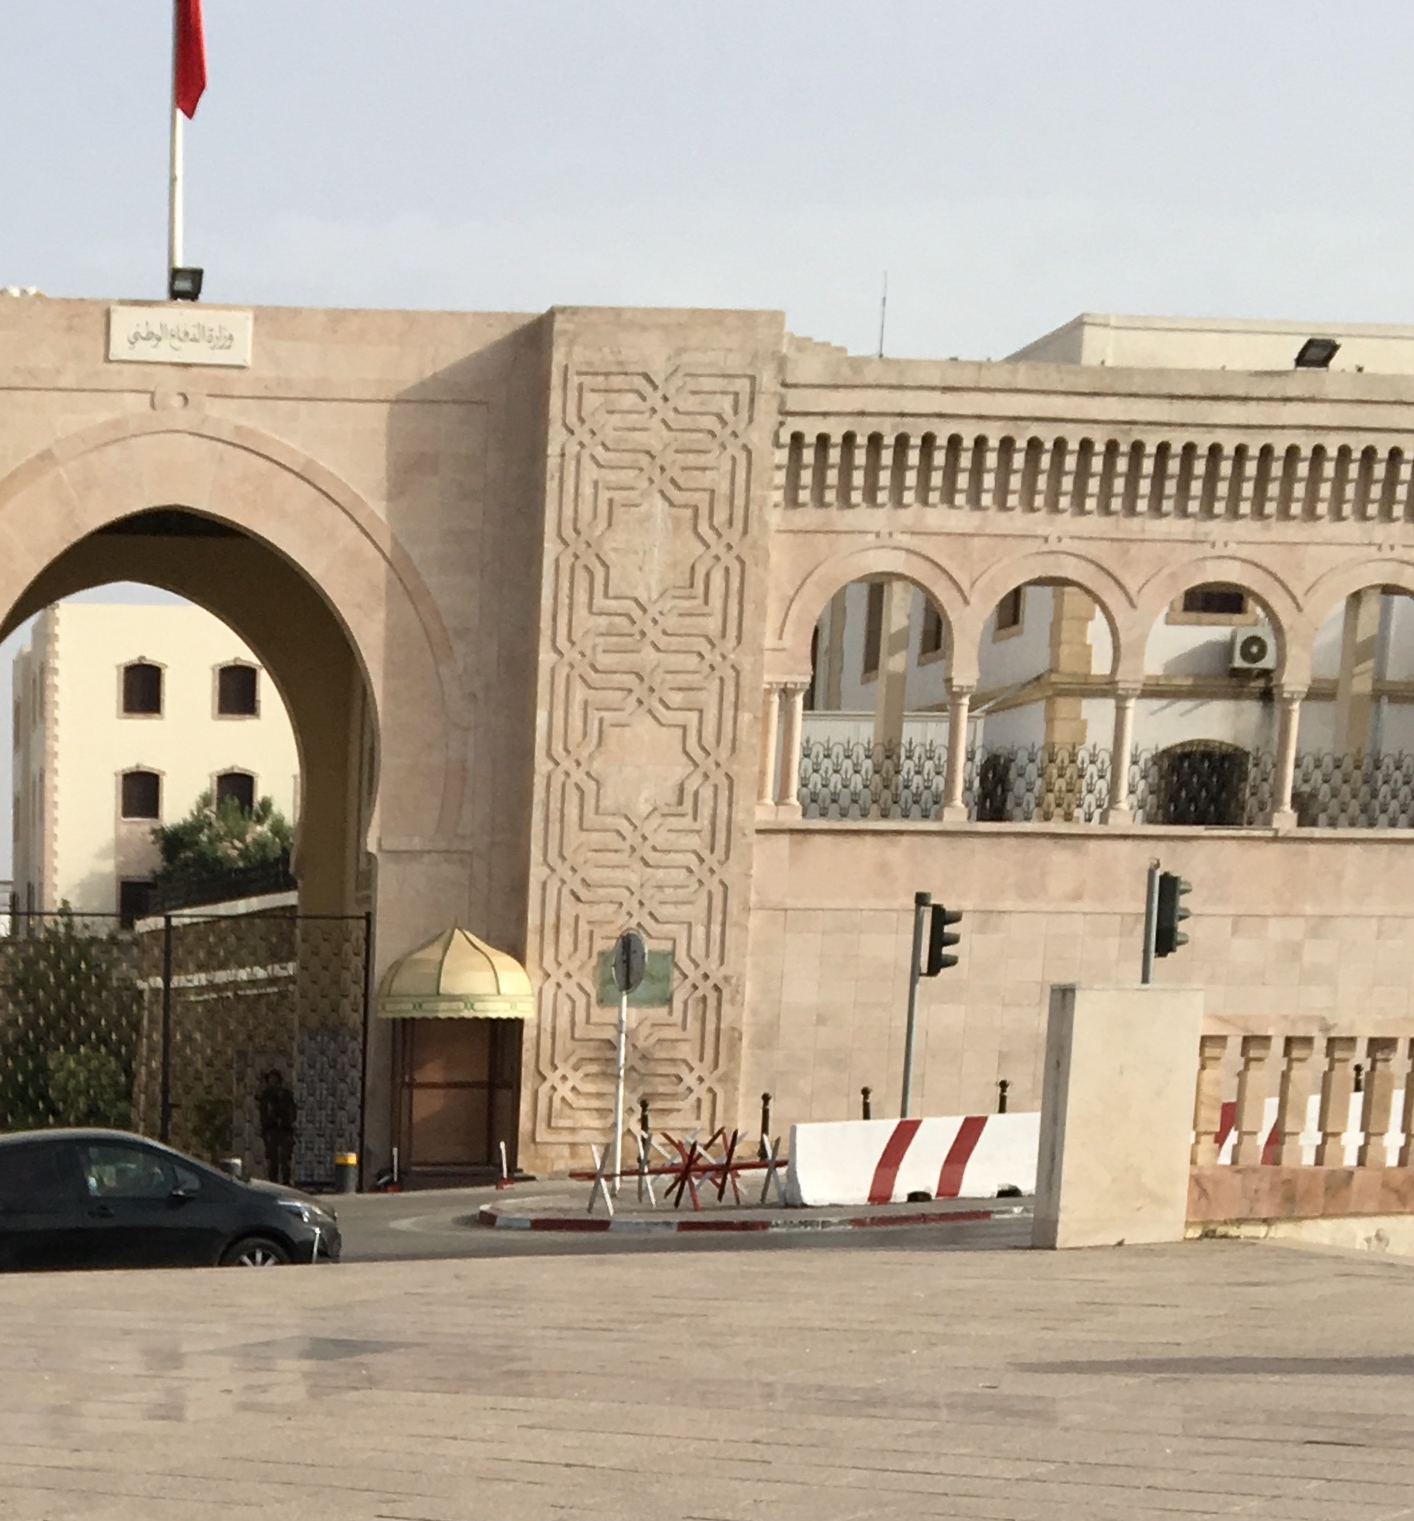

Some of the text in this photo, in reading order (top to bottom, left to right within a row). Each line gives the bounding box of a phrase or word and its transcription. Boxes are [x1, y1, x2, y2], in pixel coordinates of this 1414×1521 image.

[127, 321, 235, 352] وزارة الدفاع الوطني
